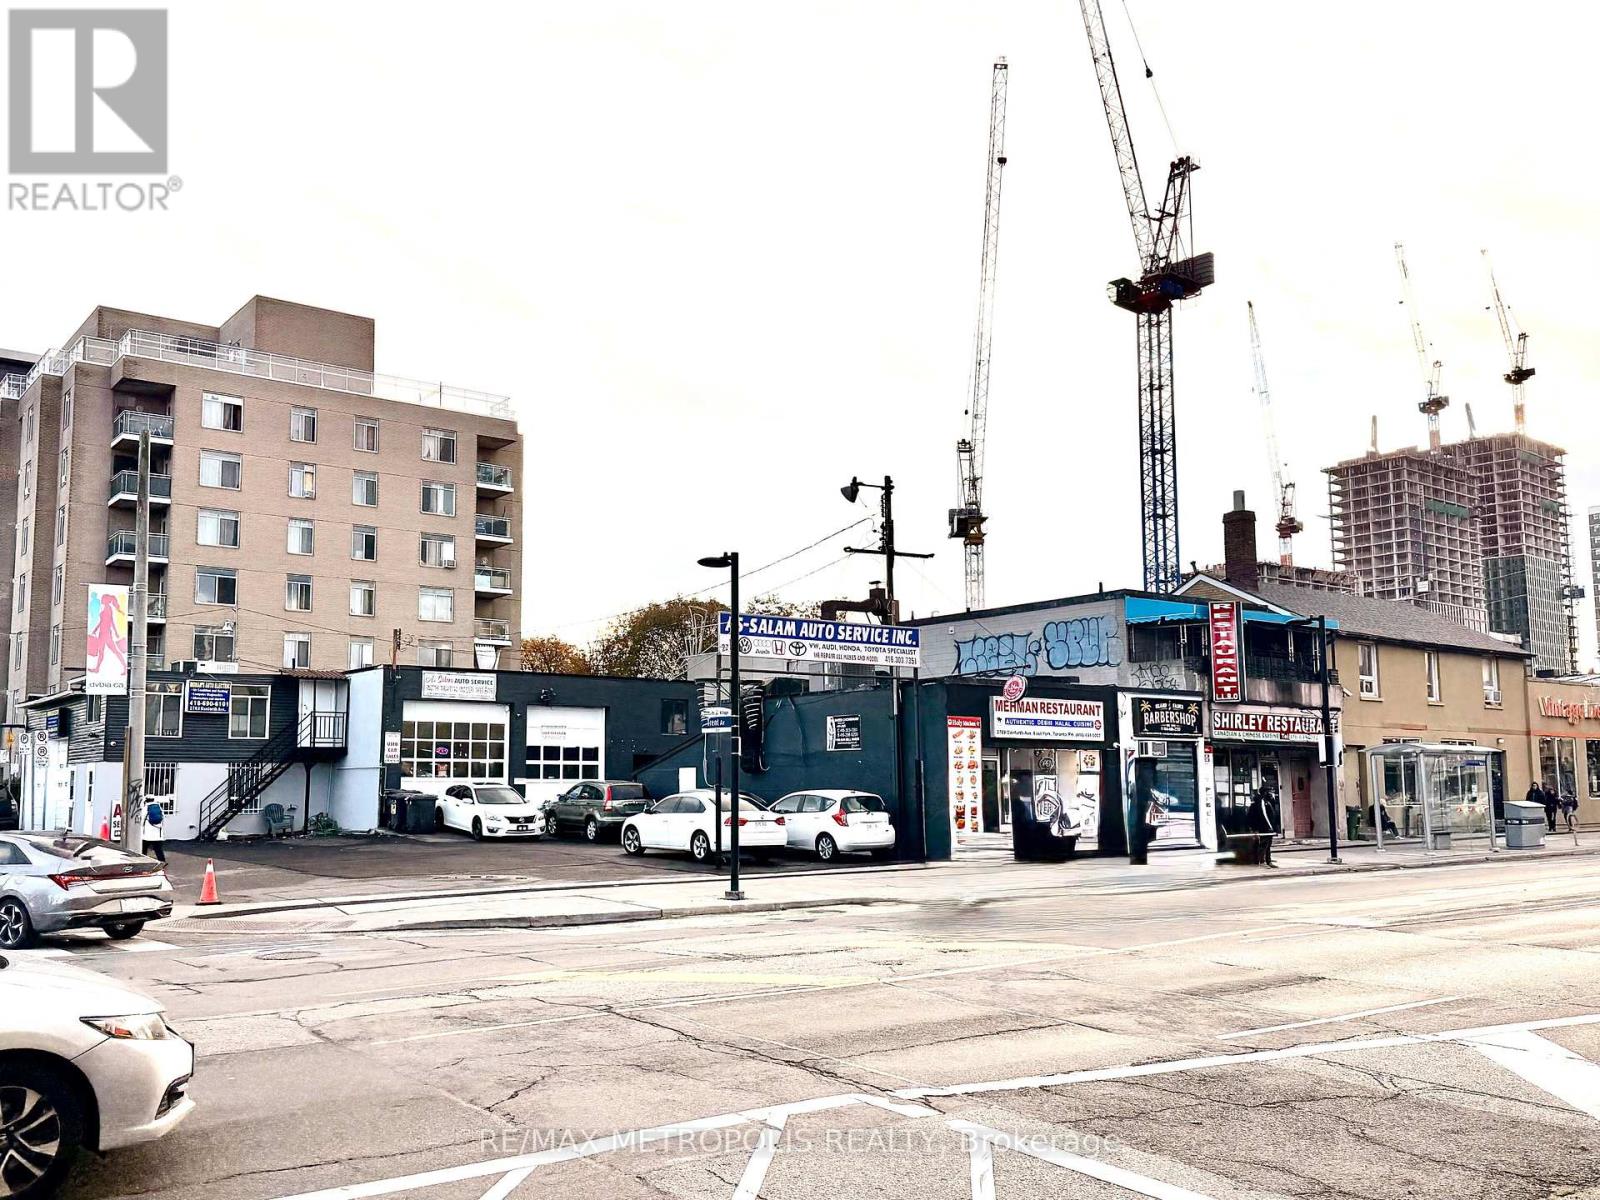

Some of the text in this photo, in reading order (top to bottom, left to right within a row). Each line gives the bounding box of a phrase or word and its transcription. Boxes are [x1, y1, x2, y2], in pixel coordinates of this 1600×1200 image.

[799, 622, 834, 640] AUTO
[837, 625, 889, 643] SERVICE
[892, 629, 917, 645] INC.
[887, 648, 916, 656] SPECIALIST
[1212, 603, 1238, 692] RESTAURANT
[995, 700, 1101, 716] MEHMAN RESTAURANT
[1005, 718, 1034, 726] AUTHENTIC
[1143, 711, 1197, 727] BARBERSHOP
[1214, 712, 1264, 730] SHIRLEY
